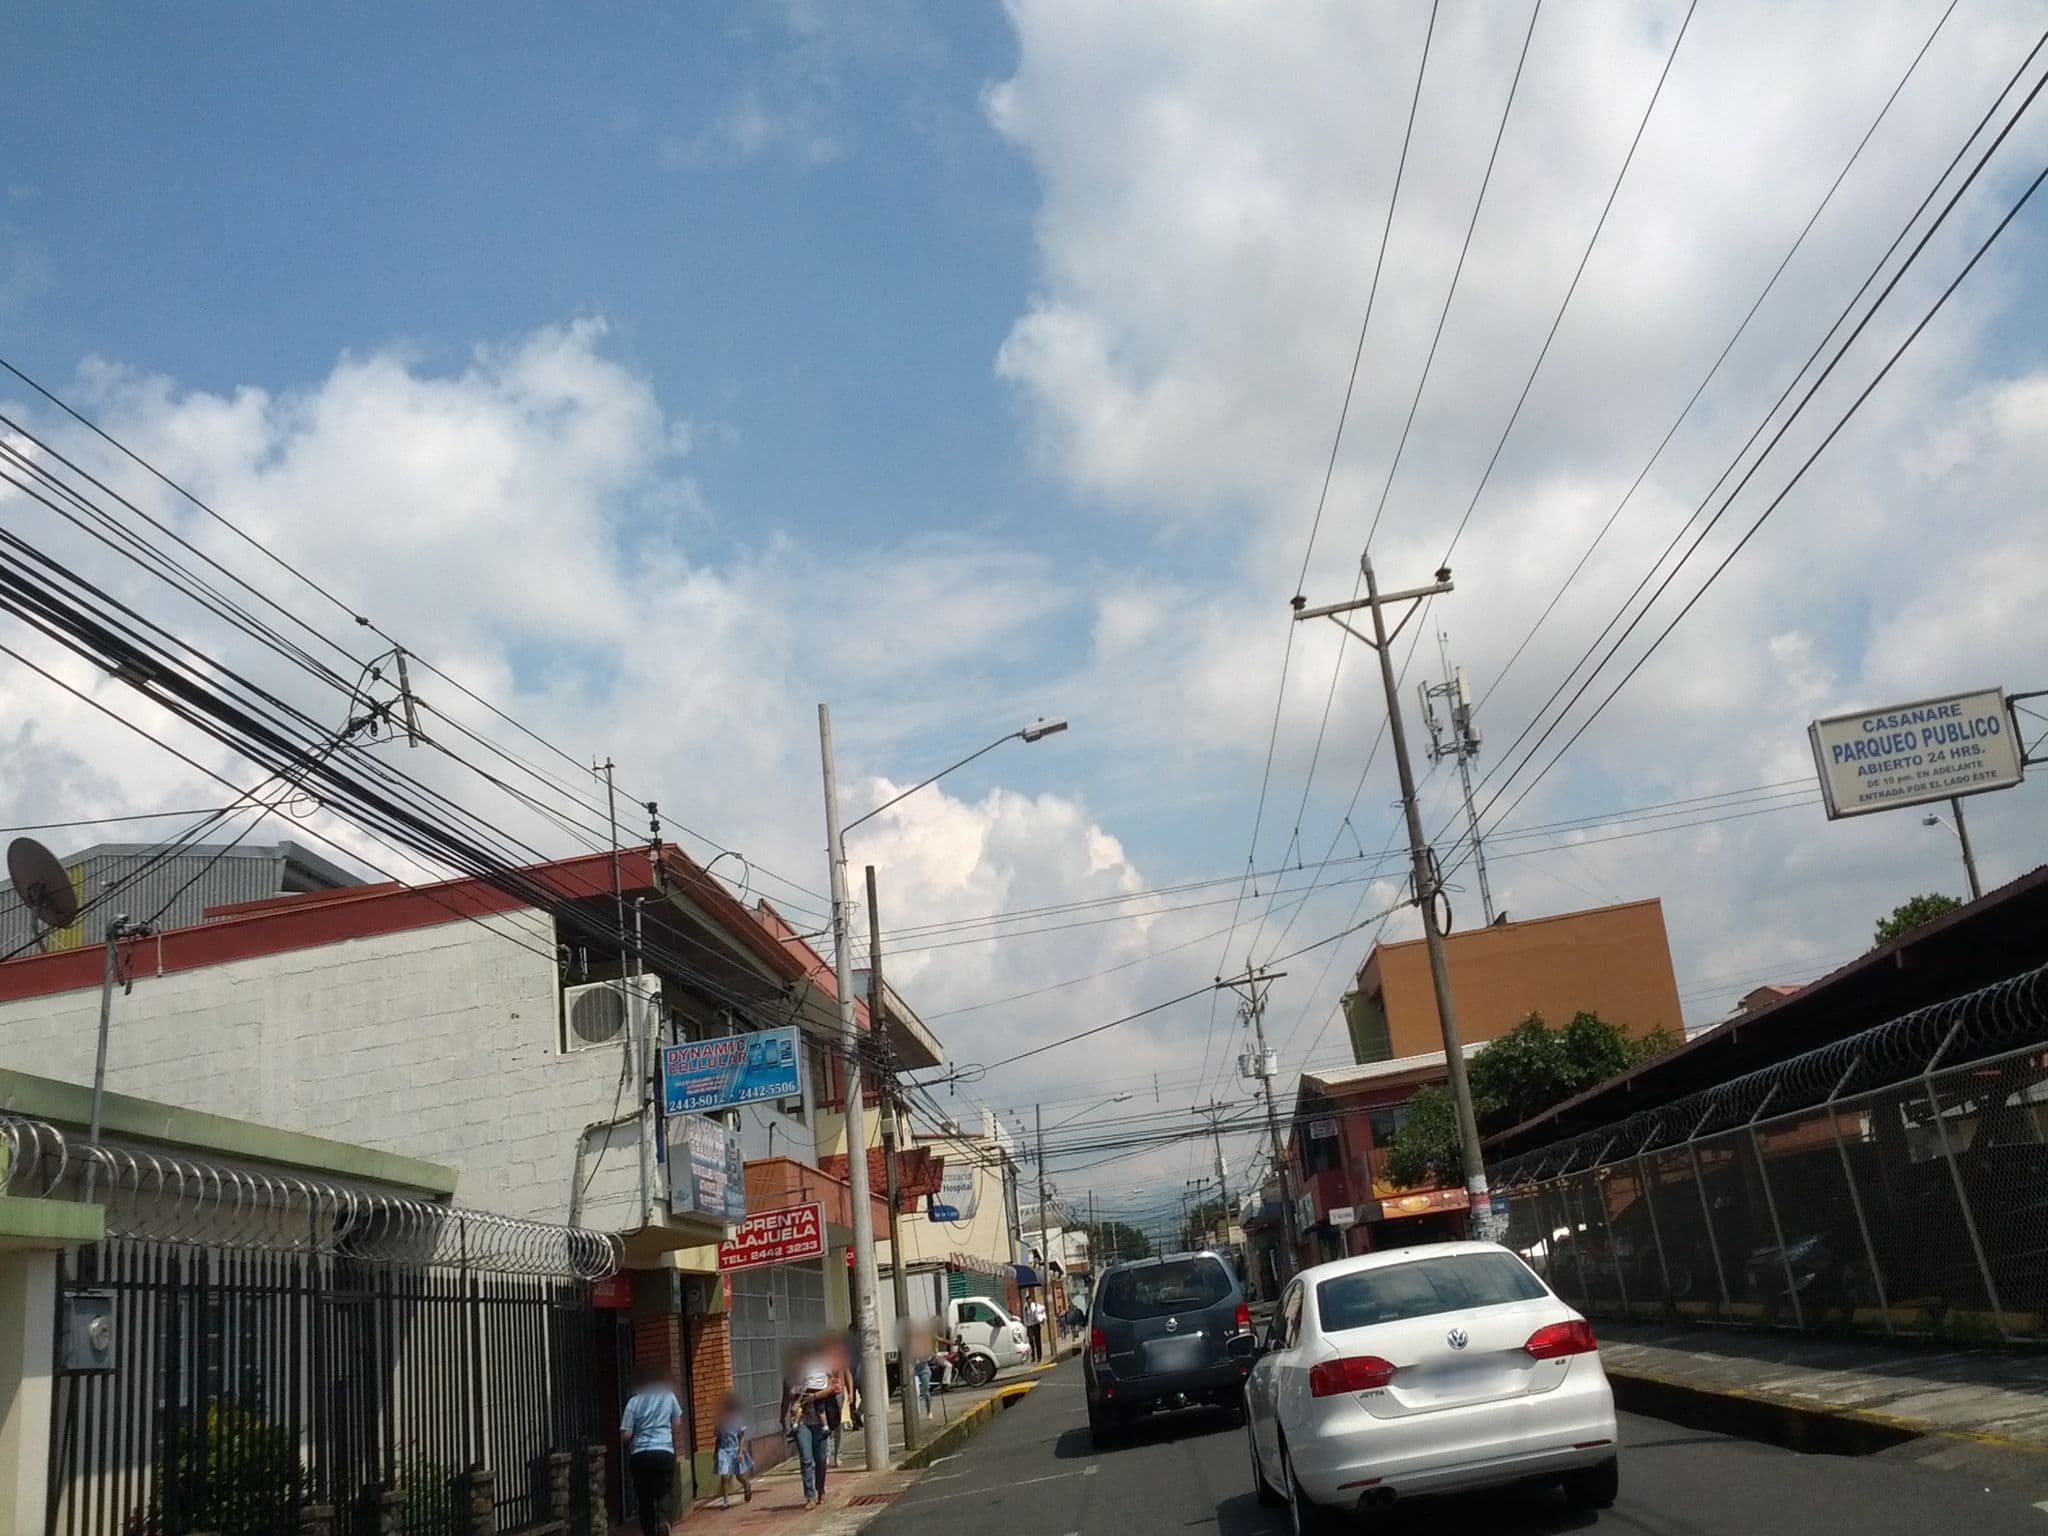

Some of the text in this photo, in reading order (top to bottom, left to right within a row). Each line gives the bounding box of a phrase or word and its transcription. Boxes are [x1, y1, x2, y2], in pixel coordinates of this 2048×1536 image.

[1862, 703, 1962, 733] CASANARE
[1832, 715, 2000, 765] PARQUEO PUBLICO
[1857, 743, 1986, 776] ABIERTO 24 HRS.
[1859, 769, 1998, 802] ENTRADA POR EL LADO ESTE
[1868, 778, 1880, 788] DE
[1917, 769, 1930, 779] EN
[1932, 760, 1984, 777] ADELANTE
[668, 1051, 748, 1075] CELLULAR
[669, 1039, 746, 1063] DYNAMIC
[669, 1093, 727, 1112] 2443-8012
[739, 1081, 796, 1099] 2442-5506
[943, 1181, 973, 1194] Hospital
[736, 1210, 815, 1236] PRENTA
[721, 1224, 817, 1252] ALAJUELA
[721, 1240, 818, 1265] TEL: 2442 3233
